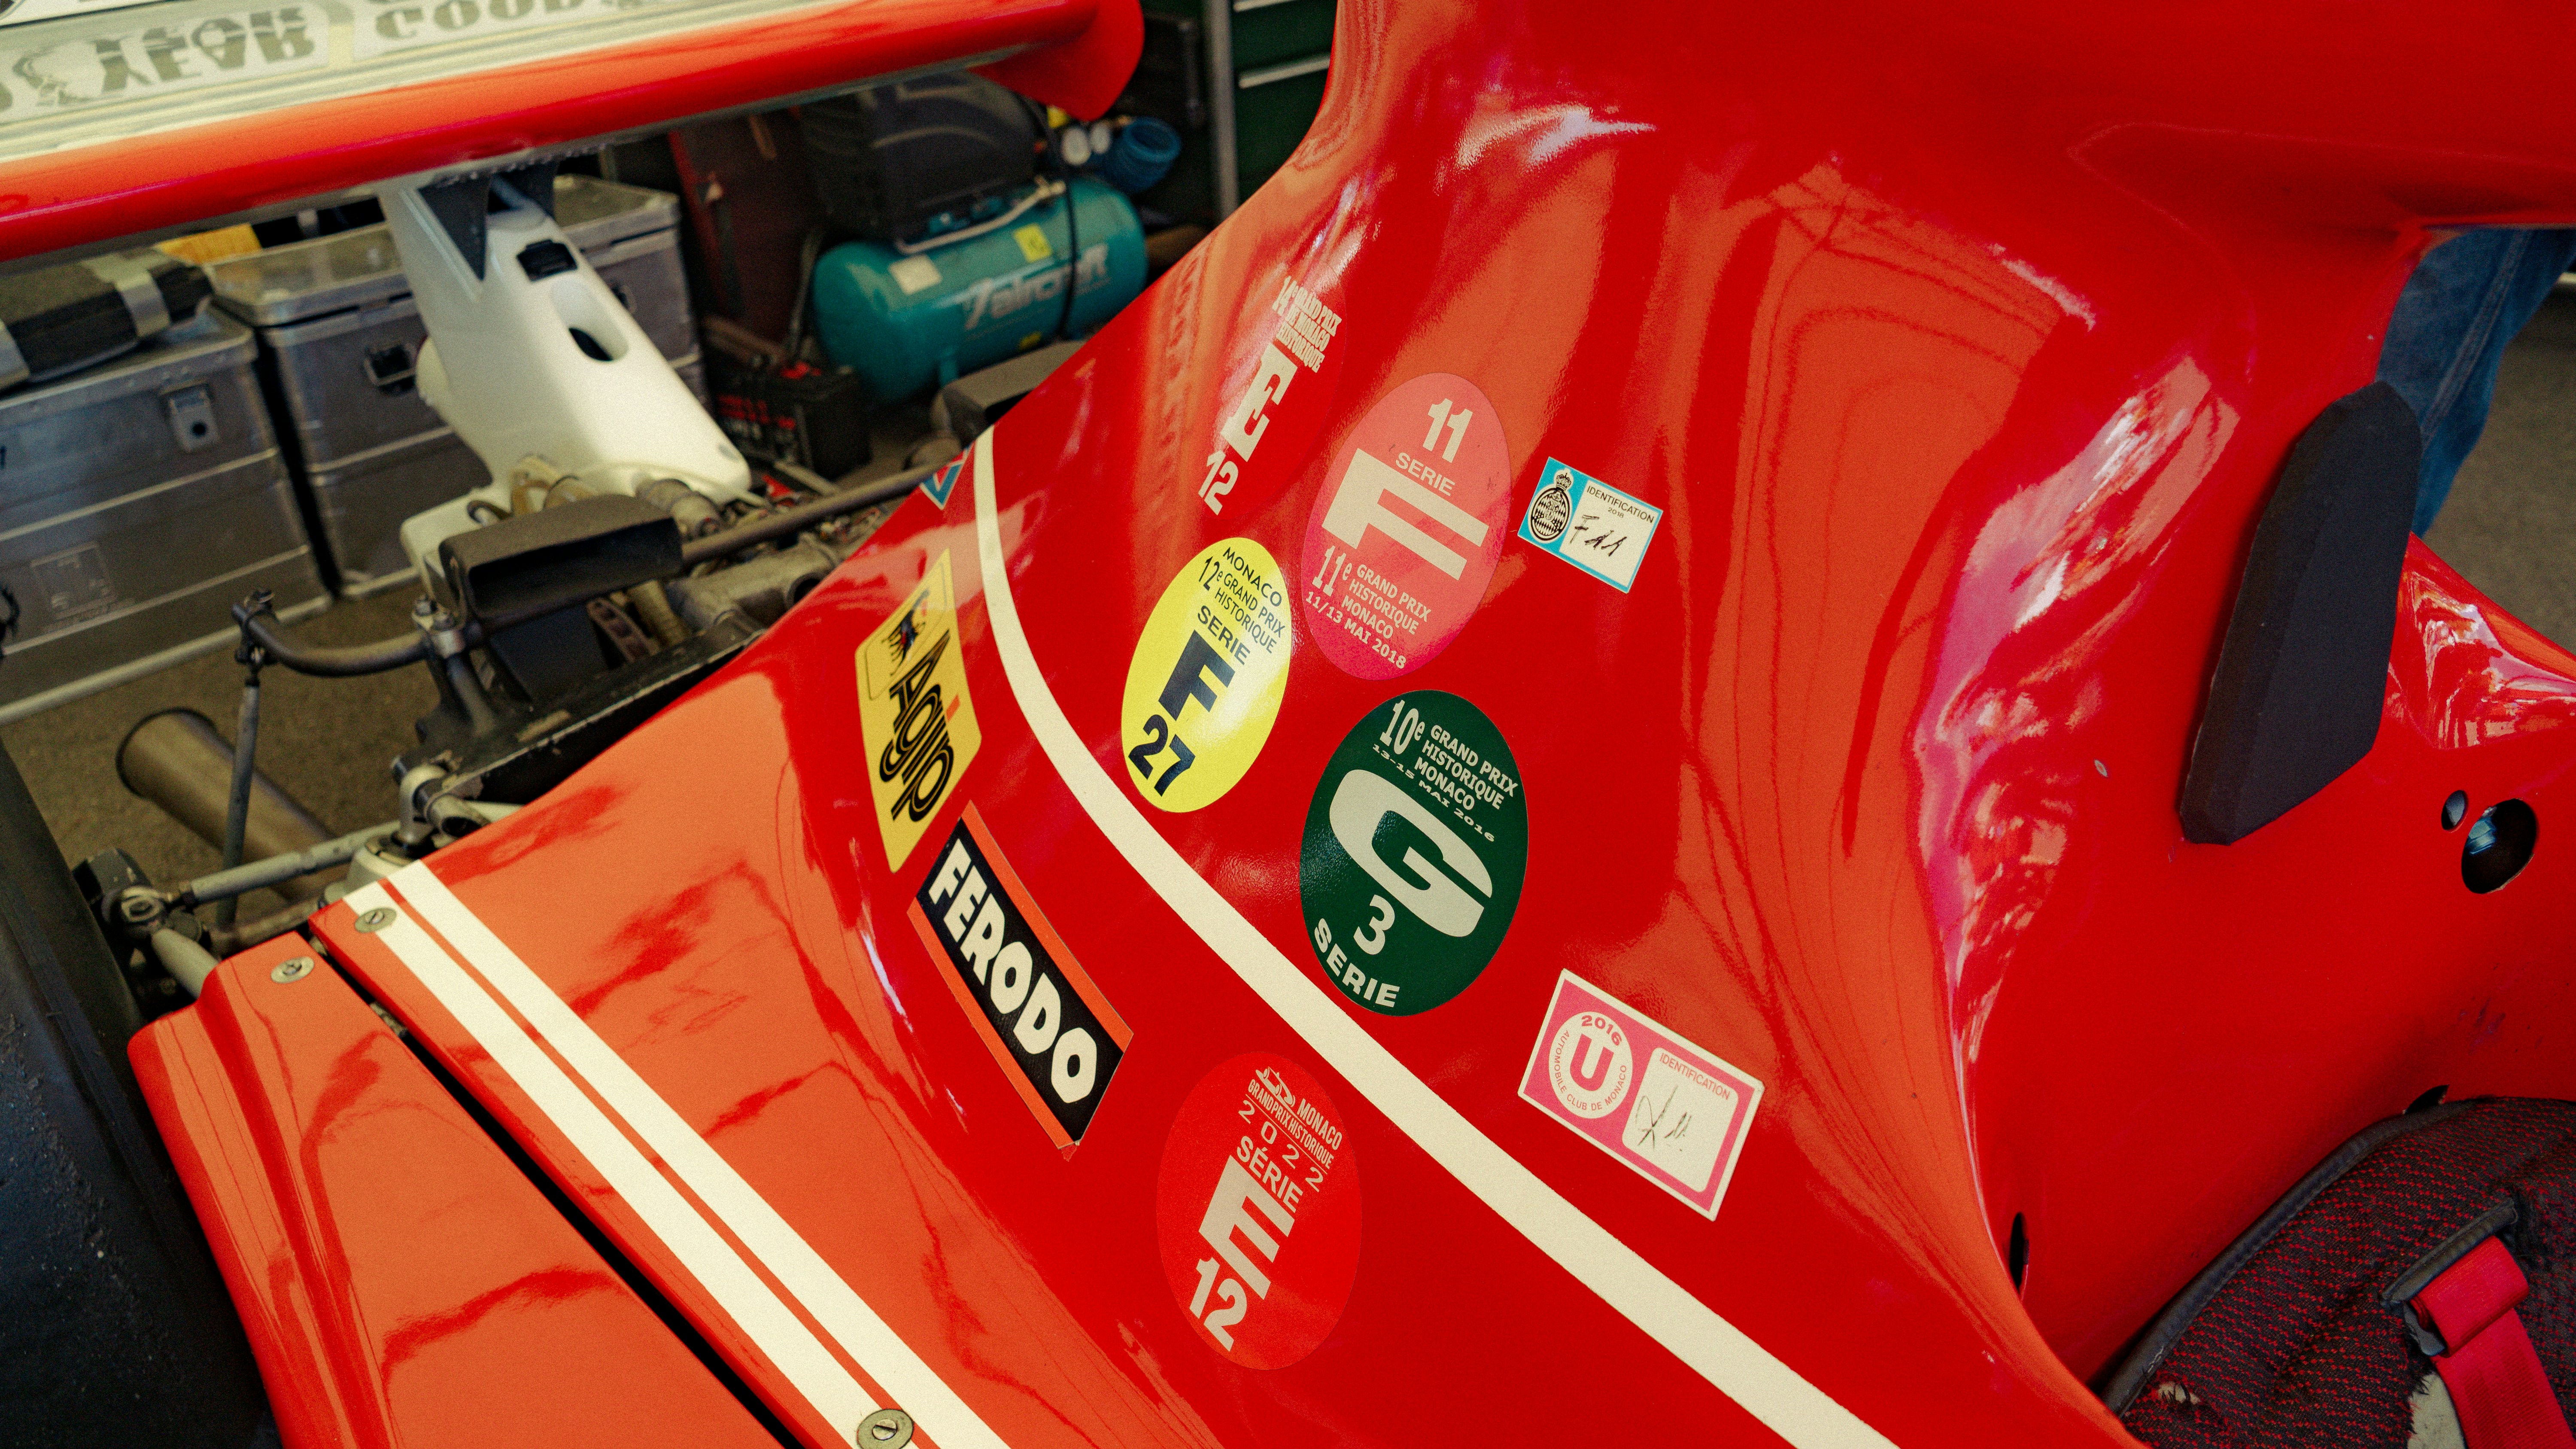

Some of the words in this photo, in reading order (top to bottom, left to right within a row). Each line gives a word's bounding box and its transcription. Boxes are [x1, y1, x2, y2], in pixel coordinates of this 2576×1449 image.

[1285, 303, 1300, 327] DE
[1294, 312, 1331, 352] MONACO
[1294, 287, 1322, 320] GRAND
[1316, 305, 1342, 337] PRIX
[1276, 321, 1325, 373] HISTORIQUE
[1220, 342, 1298, 462] E
[1422, 398, 1473, 463] 11
[1198, 450, 1239, 516] 12
[1395, 452, 1455, 496] SERIE
[1587, 486, 1654, 523] IDENTIFICATION
[1321, 448, 1489, 580] F
[1607, 507, 1624, 519] 2018
[1223, 547, 1282, 607] MONACO
[1224, 573, 1258, 611] GRAND
[1258, 606, 1285, 638] PRIX
[1349, 579, 1419, 635] HISTORIQUE
[1357, 564, 1398, 598] GRAND
[1398, 592, 1431, 622] PRIX
[1197, 605, 1251, 665] SERIE
[1215, 587, 1277, 654] HISTORIQUE
[1306, 591, 1343, 623] 11/13
[1344, 618, 1371, 644] MAI
[1372, 638, 1406, 668] 2018
[1341, 595, 1393, 639] MONACO
[1159, 629, 1235, 721] F
[879, 629, 954, 822] Agip
[1128, 714, 1196, 797] 27
[1373, 744, 1415, 779] 13-15
[1419, 780, 1450, 808] MAI
[1454, 808, 1495, 842] 2016
[1414, 756, 1475, 810] MONACO
[1422, 739, 1504, 810] HISTORIQUE
[1431, 725, 1478, 766] GRAND
[1479, 760, 1518, 797] PRIX
[1329, 769, 1493, 938] G
[1353, 894, 1395, 955] 3
[928, 838, 1097, 1104] FERODO
[1314, 918, 1400, 1008] SERIE
[1570, 1033, 1614, 1091] U
[1581, 1015, 1622, 1046] 2016
[1554, 1030, 1570, 1093] AUTOMOBILE
[1567, 1094, 1587, 1110] CLUB
[1591, 1102, 1602, 1111] DE
[1604, 1065, 1627, 1106] MONACO
[1659, 1052, 1730, 1100] IDENTIFICATION
[1297, 1098, 1342, 1150] MONACO
[1237, 1136, 1303, 1213] SÉRIE
[1199, 1154, 1295, 1300] E
[1189, 1257, 1247, 1352] 12
